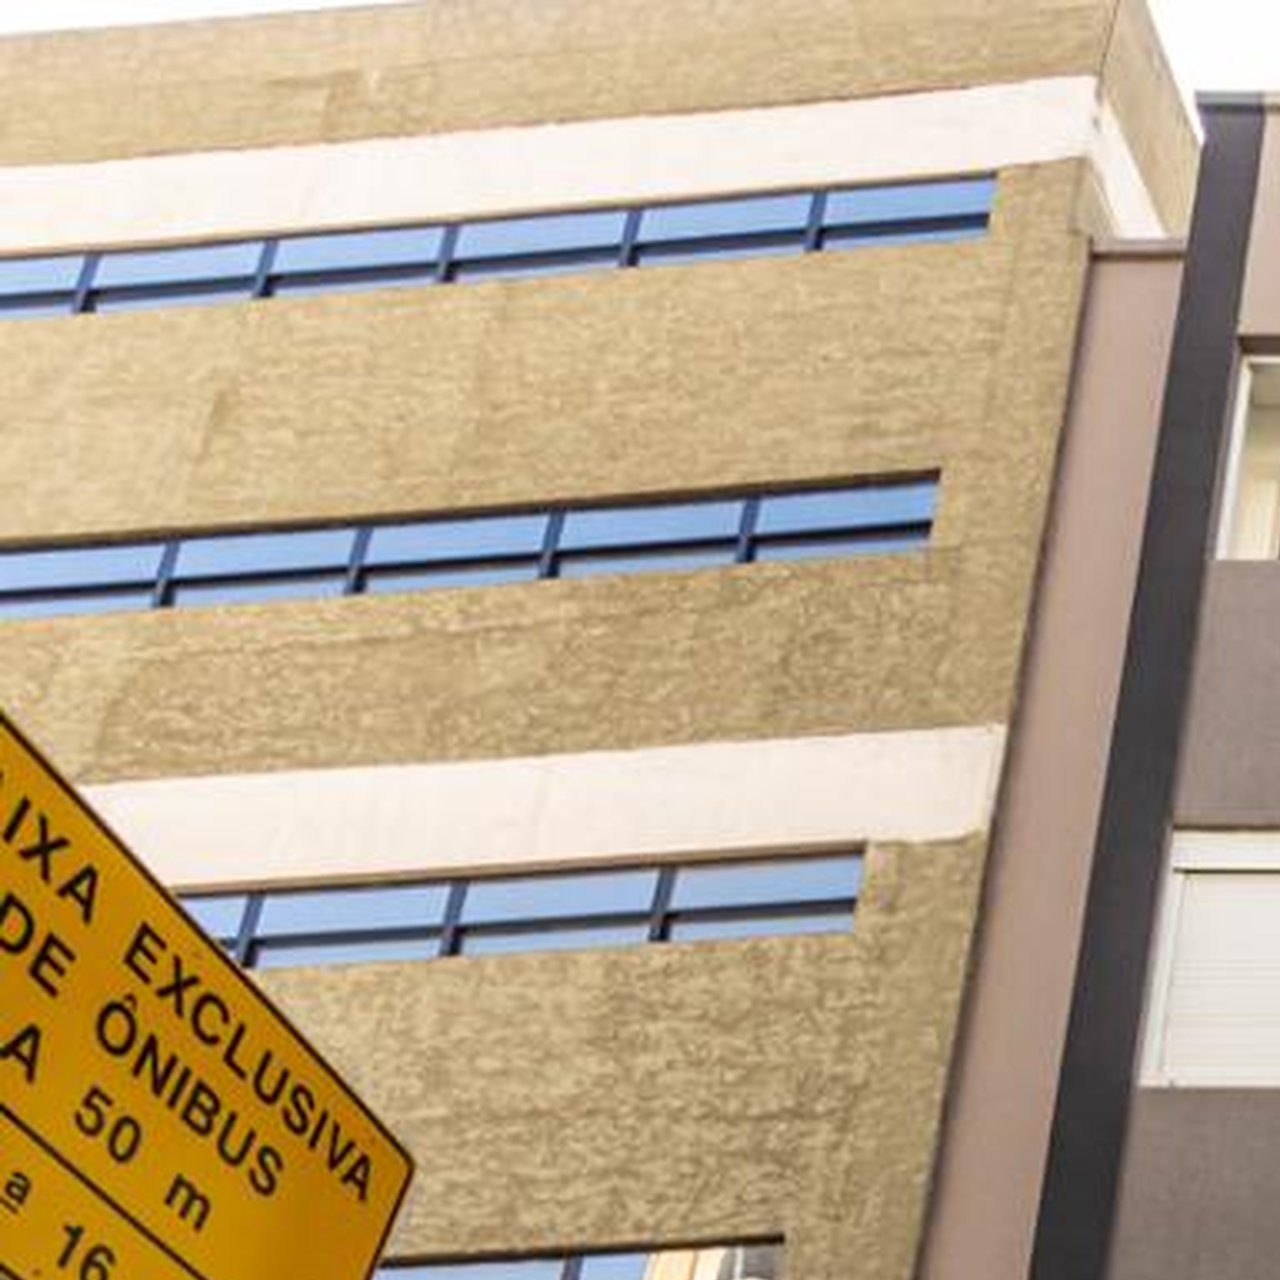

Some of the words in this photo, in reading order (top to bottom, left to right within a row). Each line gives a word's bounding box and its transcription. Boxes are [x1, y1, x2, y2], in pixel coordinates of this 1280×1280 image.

[0, 770, 97, 926] IXA
[122, 922, 373, 1203] EXCLUSIVA
[0, 892, 77, 998] DE
[96, 993, 284, 1196] ÔNIBUS
[0, 1023, 41, 1084] A
[75, 1086, 141, 1164] 50
[163, 1172, 212, 1232] m
